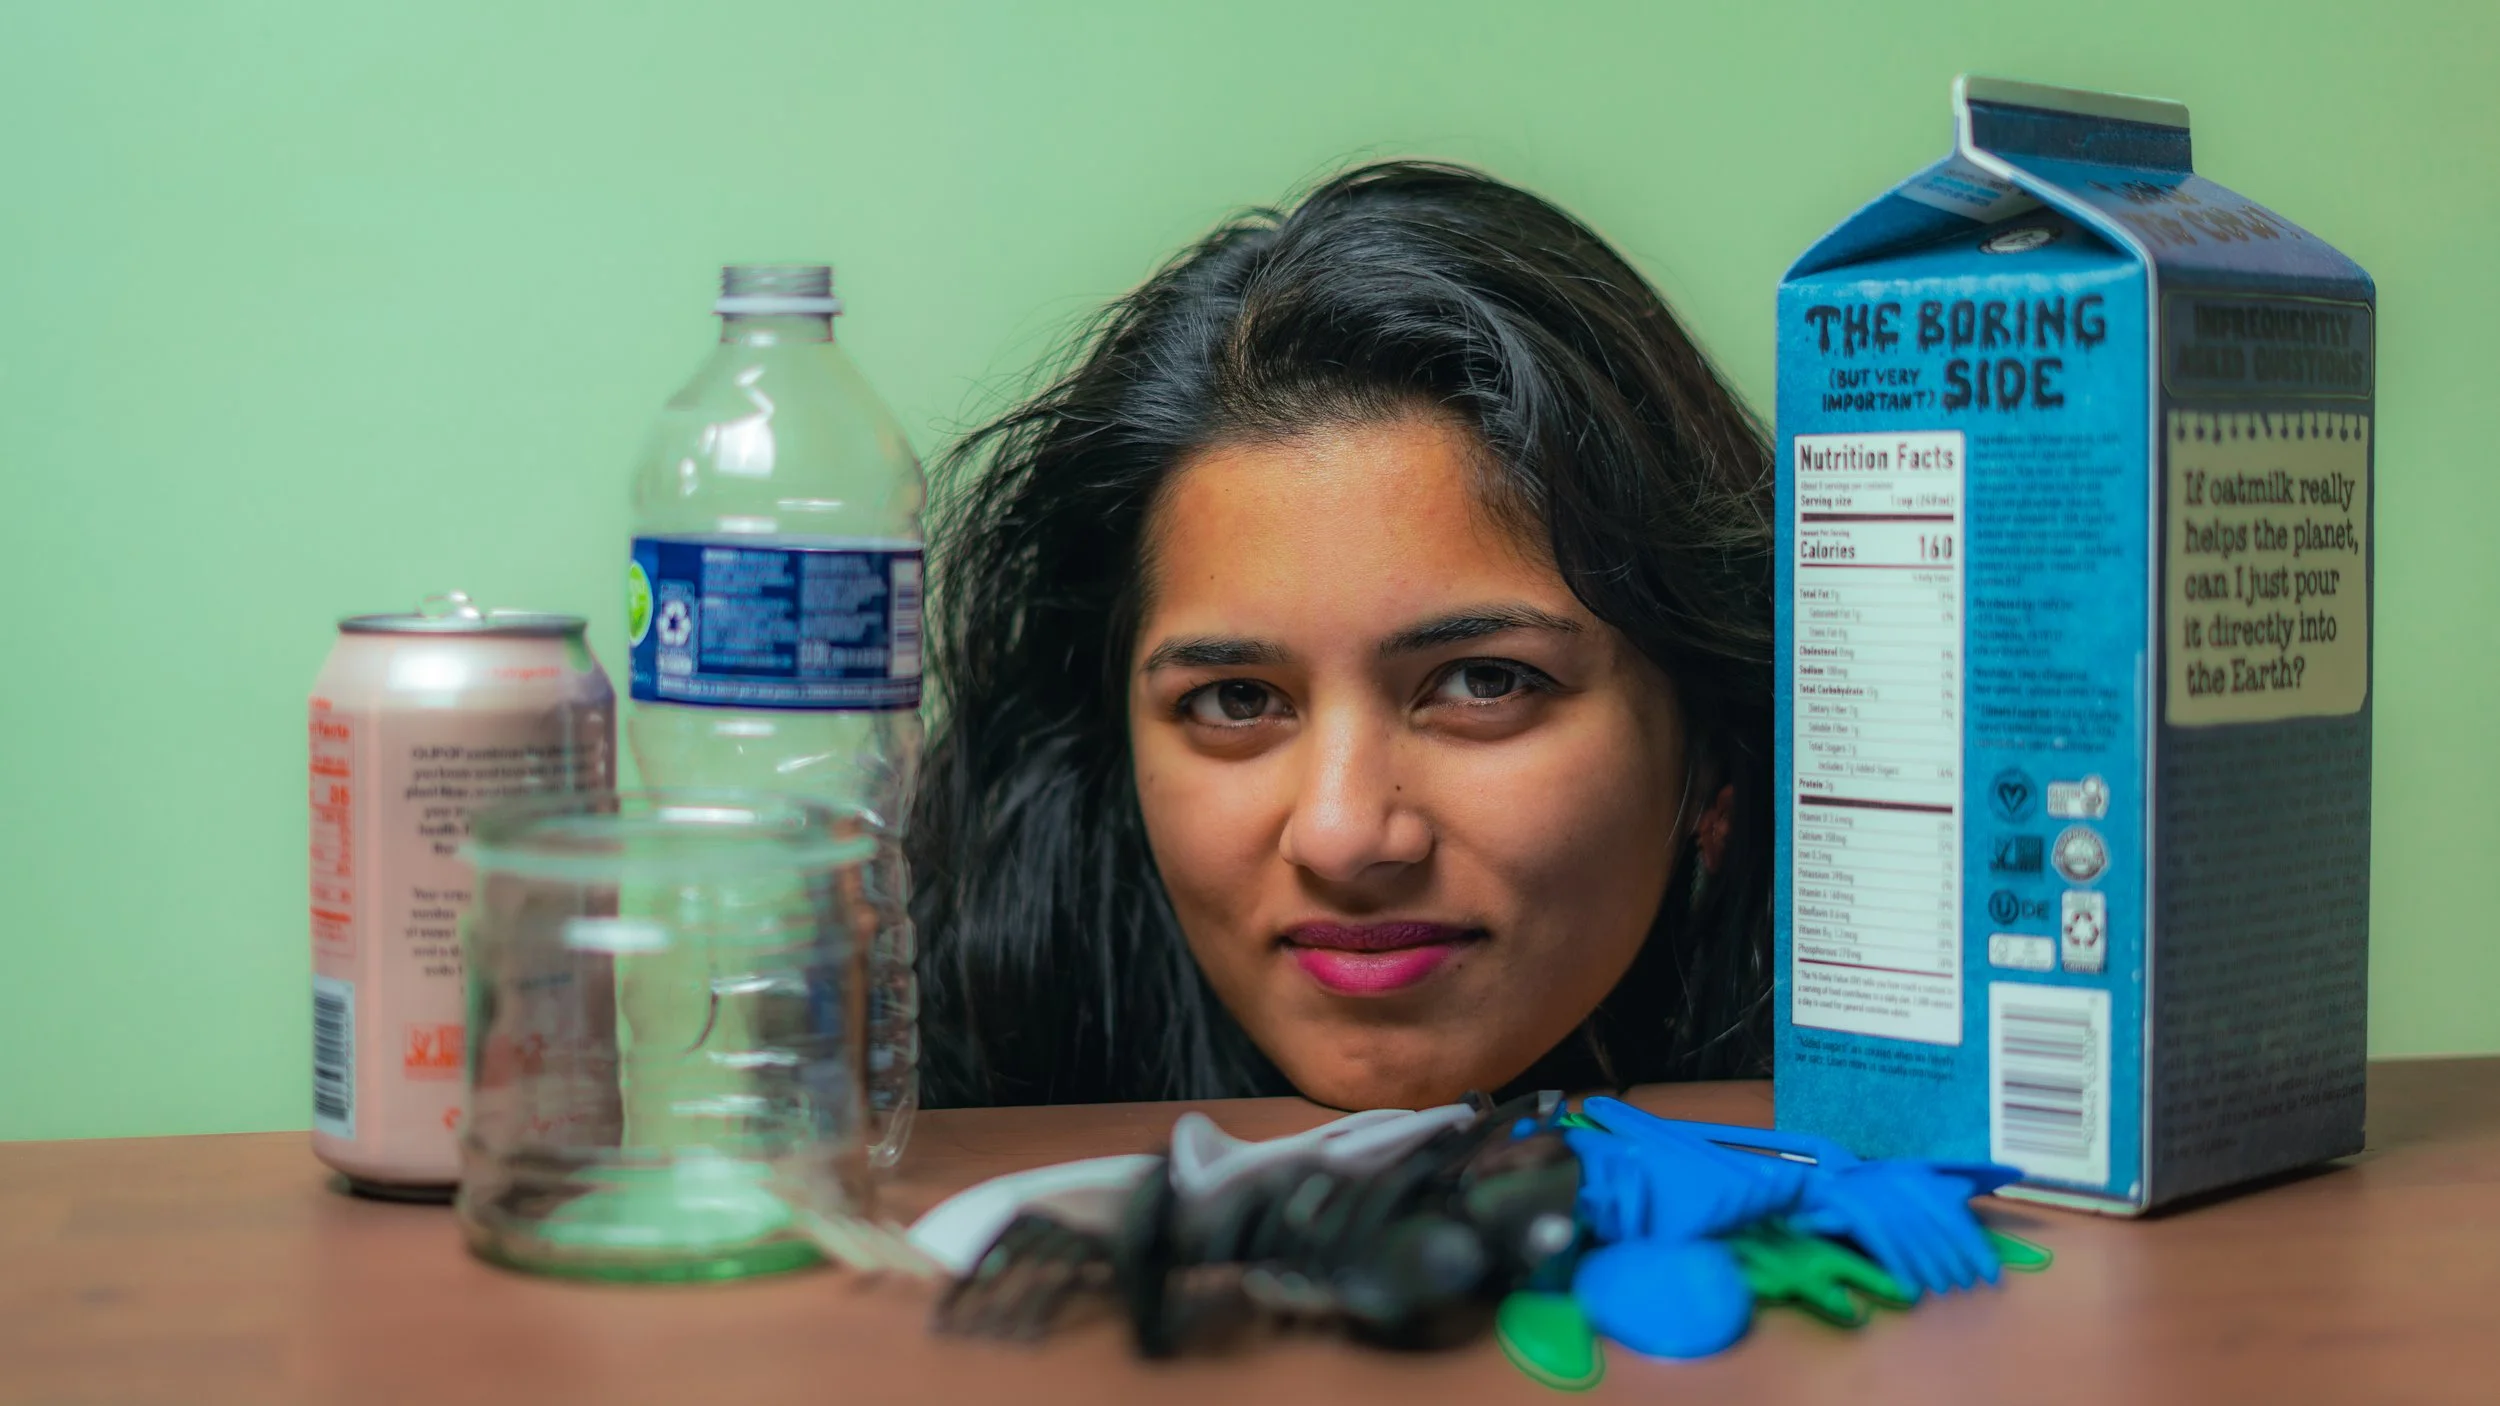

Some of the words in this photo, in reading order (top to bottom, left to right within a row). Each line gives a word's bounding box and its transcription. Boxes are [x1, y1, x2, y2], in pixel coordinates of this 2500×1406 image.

[1804, 302, 1901, 354] THE
[1917, 294, 2105, 349] BORING
[1829, 367, 1870, 389] (BUT
[1874, 367, 1921, 387] VERY
[1942, 357, 2064, 413] SIDE
[1822, 389, 1935, 412] IMPORTANT)
[1800, 443, 1888, 471] Nutrition
[1897, 442, 1954, 469] Facts
[2183, 469, 2205, 506] If
[2210, 471, 2294, 505] oatmilk
[2298, 472, 2355, 512] really
[1800, 494, 1832, 509] Serving
[1835, 494, 1852, 506] size
[1897, 497, 1913, 509] cup
[2184, 518, 2248, 559] helps
[2253, 518, 2288, 550] the
[2293, 518, 2359, 558] planet,
[1800, 540, 1855, 559] Calories
[1920, 535, 1953, 560] 160
[2184, 573, 2229, 601] can
[2235, 565, 2243, 600] I
[2246, 566, 2289, 607] just
[2294, 569, 2340, 605] pour
[1800, 589, 1816, 599] Total
[1818, 590, 1829, 599] Fat
[2183, 614, 2202, 651] it
[2208, 610, 2294, 651] directly
[2298, 608, 2337, 645] into
[1800, 645, 1838, 656] Cholesterol
[1800, 665, 1824, 675] Sodium
[2186, 660, 2226, 698] the
[2230, 656, 2305, 694] Earth?
[1799, 684, 1816, 694] Total
[1818, 684, 1864, 697] Carbohydrate
[1808, 740, 1823, 751] Total
[1799, 778, 1823, 789] Protein
[1798, 811, 1822, 822] Vitamin
[1798, 830, 1823, 841] Calcium
[1798, 867, 1830, 879] Potassium
[1798, 886, 1822, 897] Vitamin
[1798, 924, 1821, 935] Vitamin
